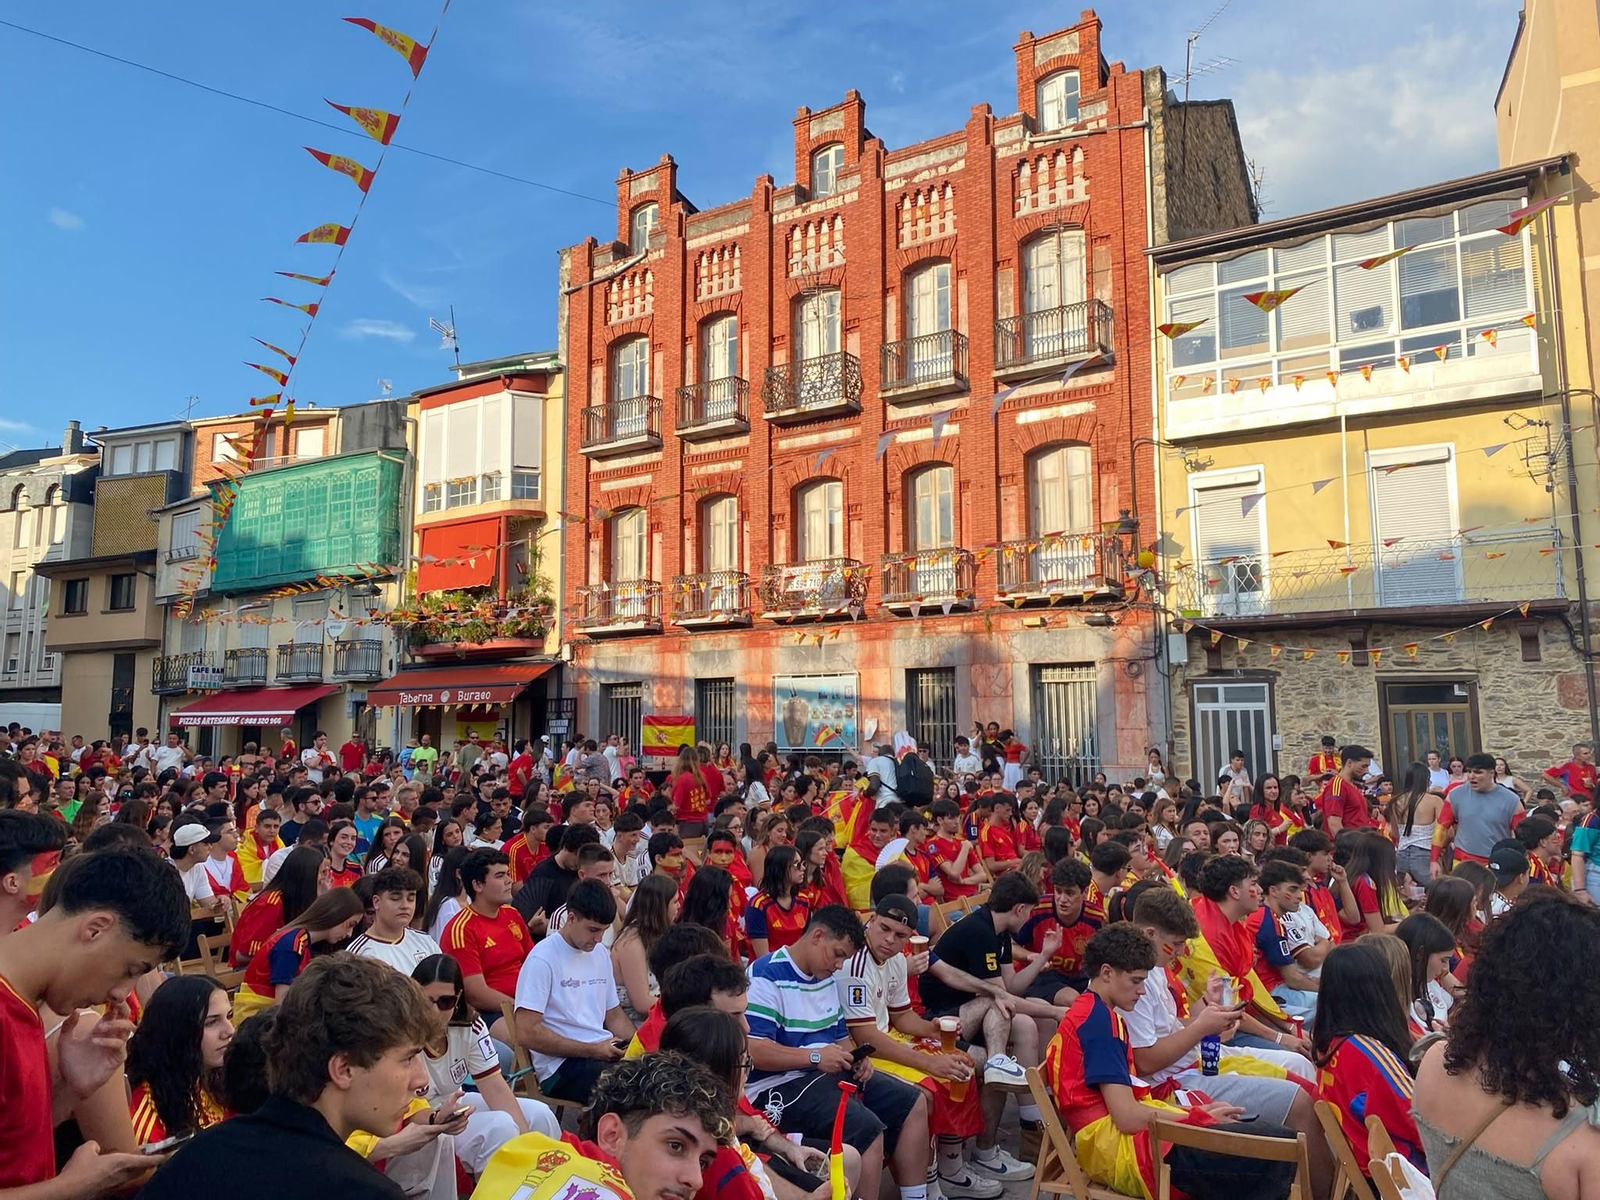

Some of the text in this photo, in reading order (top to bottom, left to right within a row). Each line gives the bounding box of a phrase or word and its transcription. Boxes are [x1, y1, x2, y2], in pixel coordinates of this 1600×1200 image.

[191, 666, 209, 674] CAFE
[399, 692, 433, 704] Taberna
[178, 717, 201, 725] PIZZAS
[201, 716, 240, 725] ARTESANAS
[985, 952, 997, 971] 5
